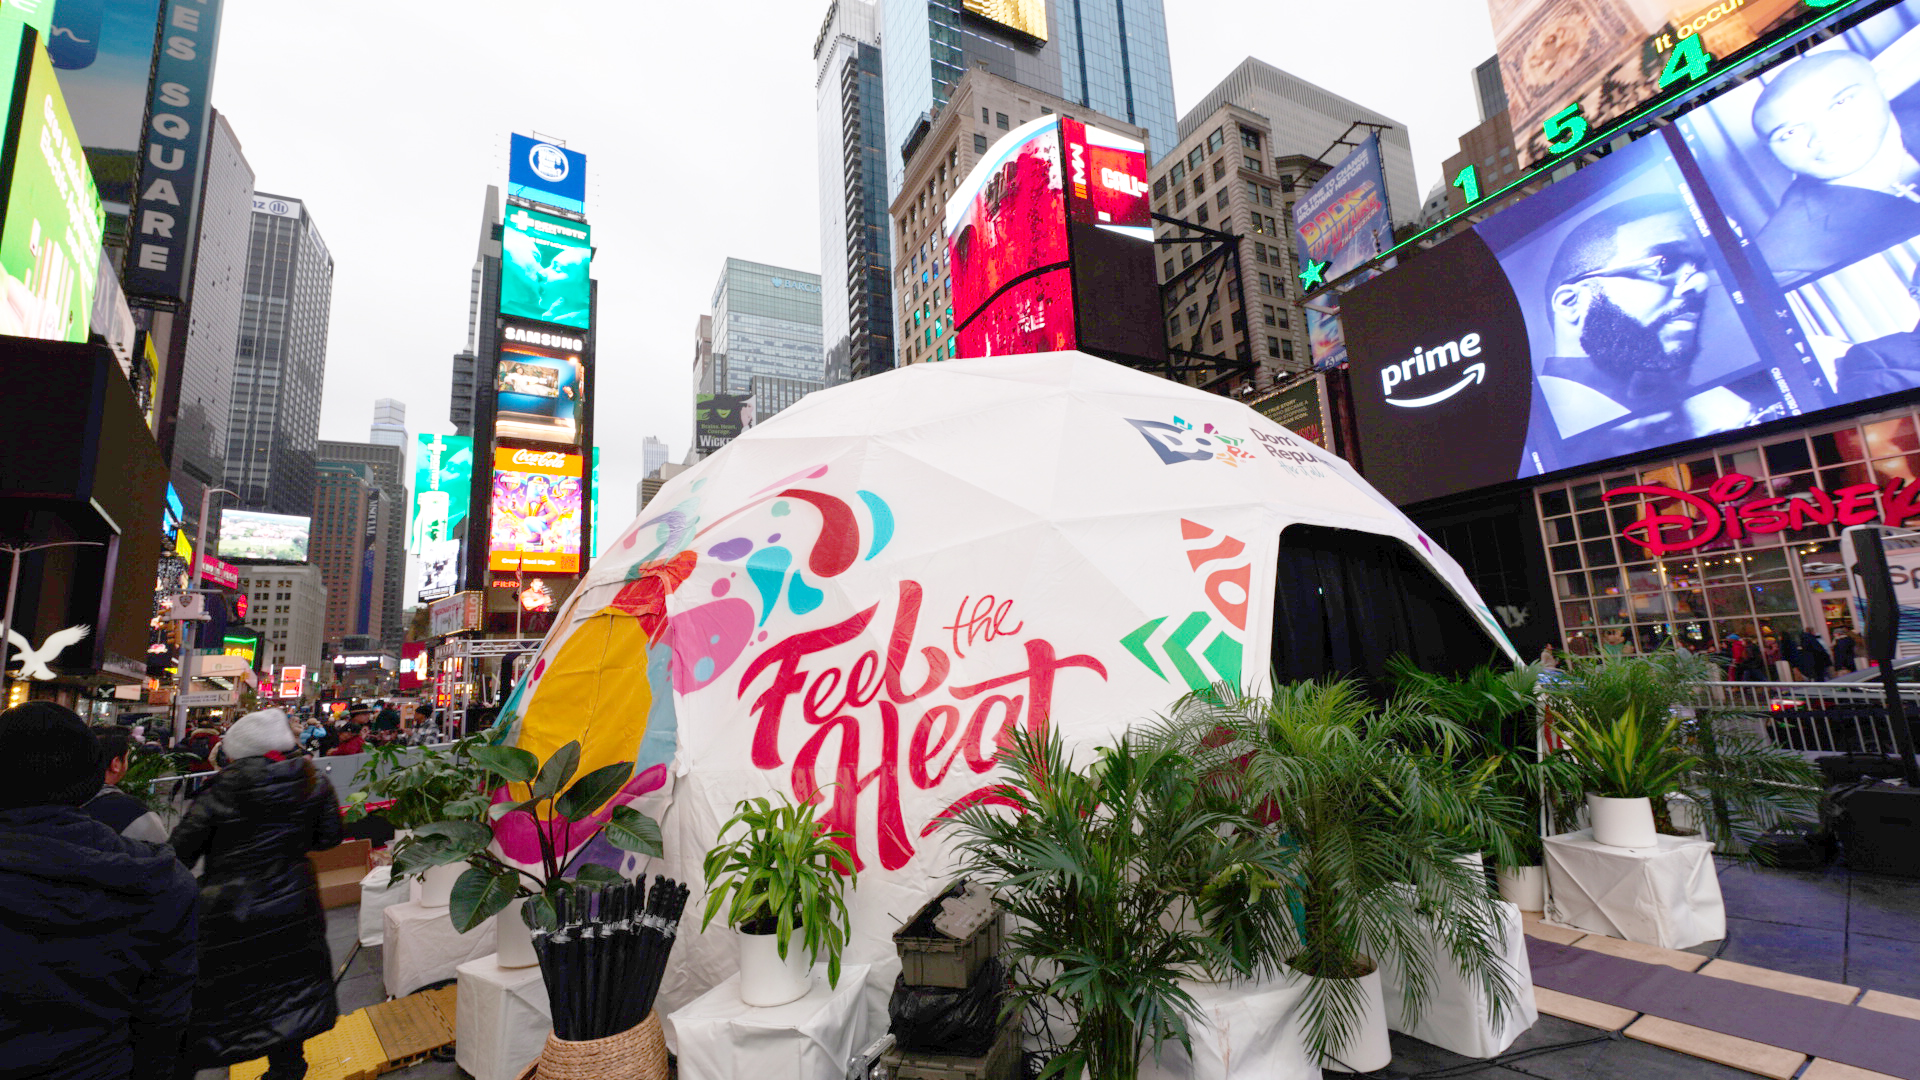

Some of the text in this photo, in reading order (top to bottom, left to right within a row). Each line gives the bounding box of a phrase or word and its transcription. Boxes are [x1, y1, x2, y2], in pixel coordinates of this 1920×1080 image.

[1655, 33, 1673, 53] It
[1658, 32, 1711, 88] 4
[138, 5, 201, 272] ES SQUARE
[1543, 103, 1588, 155] 5
[1101, 167, 1142, 198] CALL
[1297, 156, 1370, 224] BROADWAY HISTORY!
[1309, 187, 1324, 203] TIME
[1324, 177, 1335, 191] TO
[1336, 148, 1369, 181] CHANGE
[1453, 164, 1480, 204] 1
[1299, 185, 1368, 246] BACK
[1322, 190, 1378, 256] FUTURE
[505, 326, 583, 351] SAMSUNG
[1381, 332, 1482, 396] prime
[737, 579, 1023, 771] Feel the
[790, 638, 1109, 877] Heat
